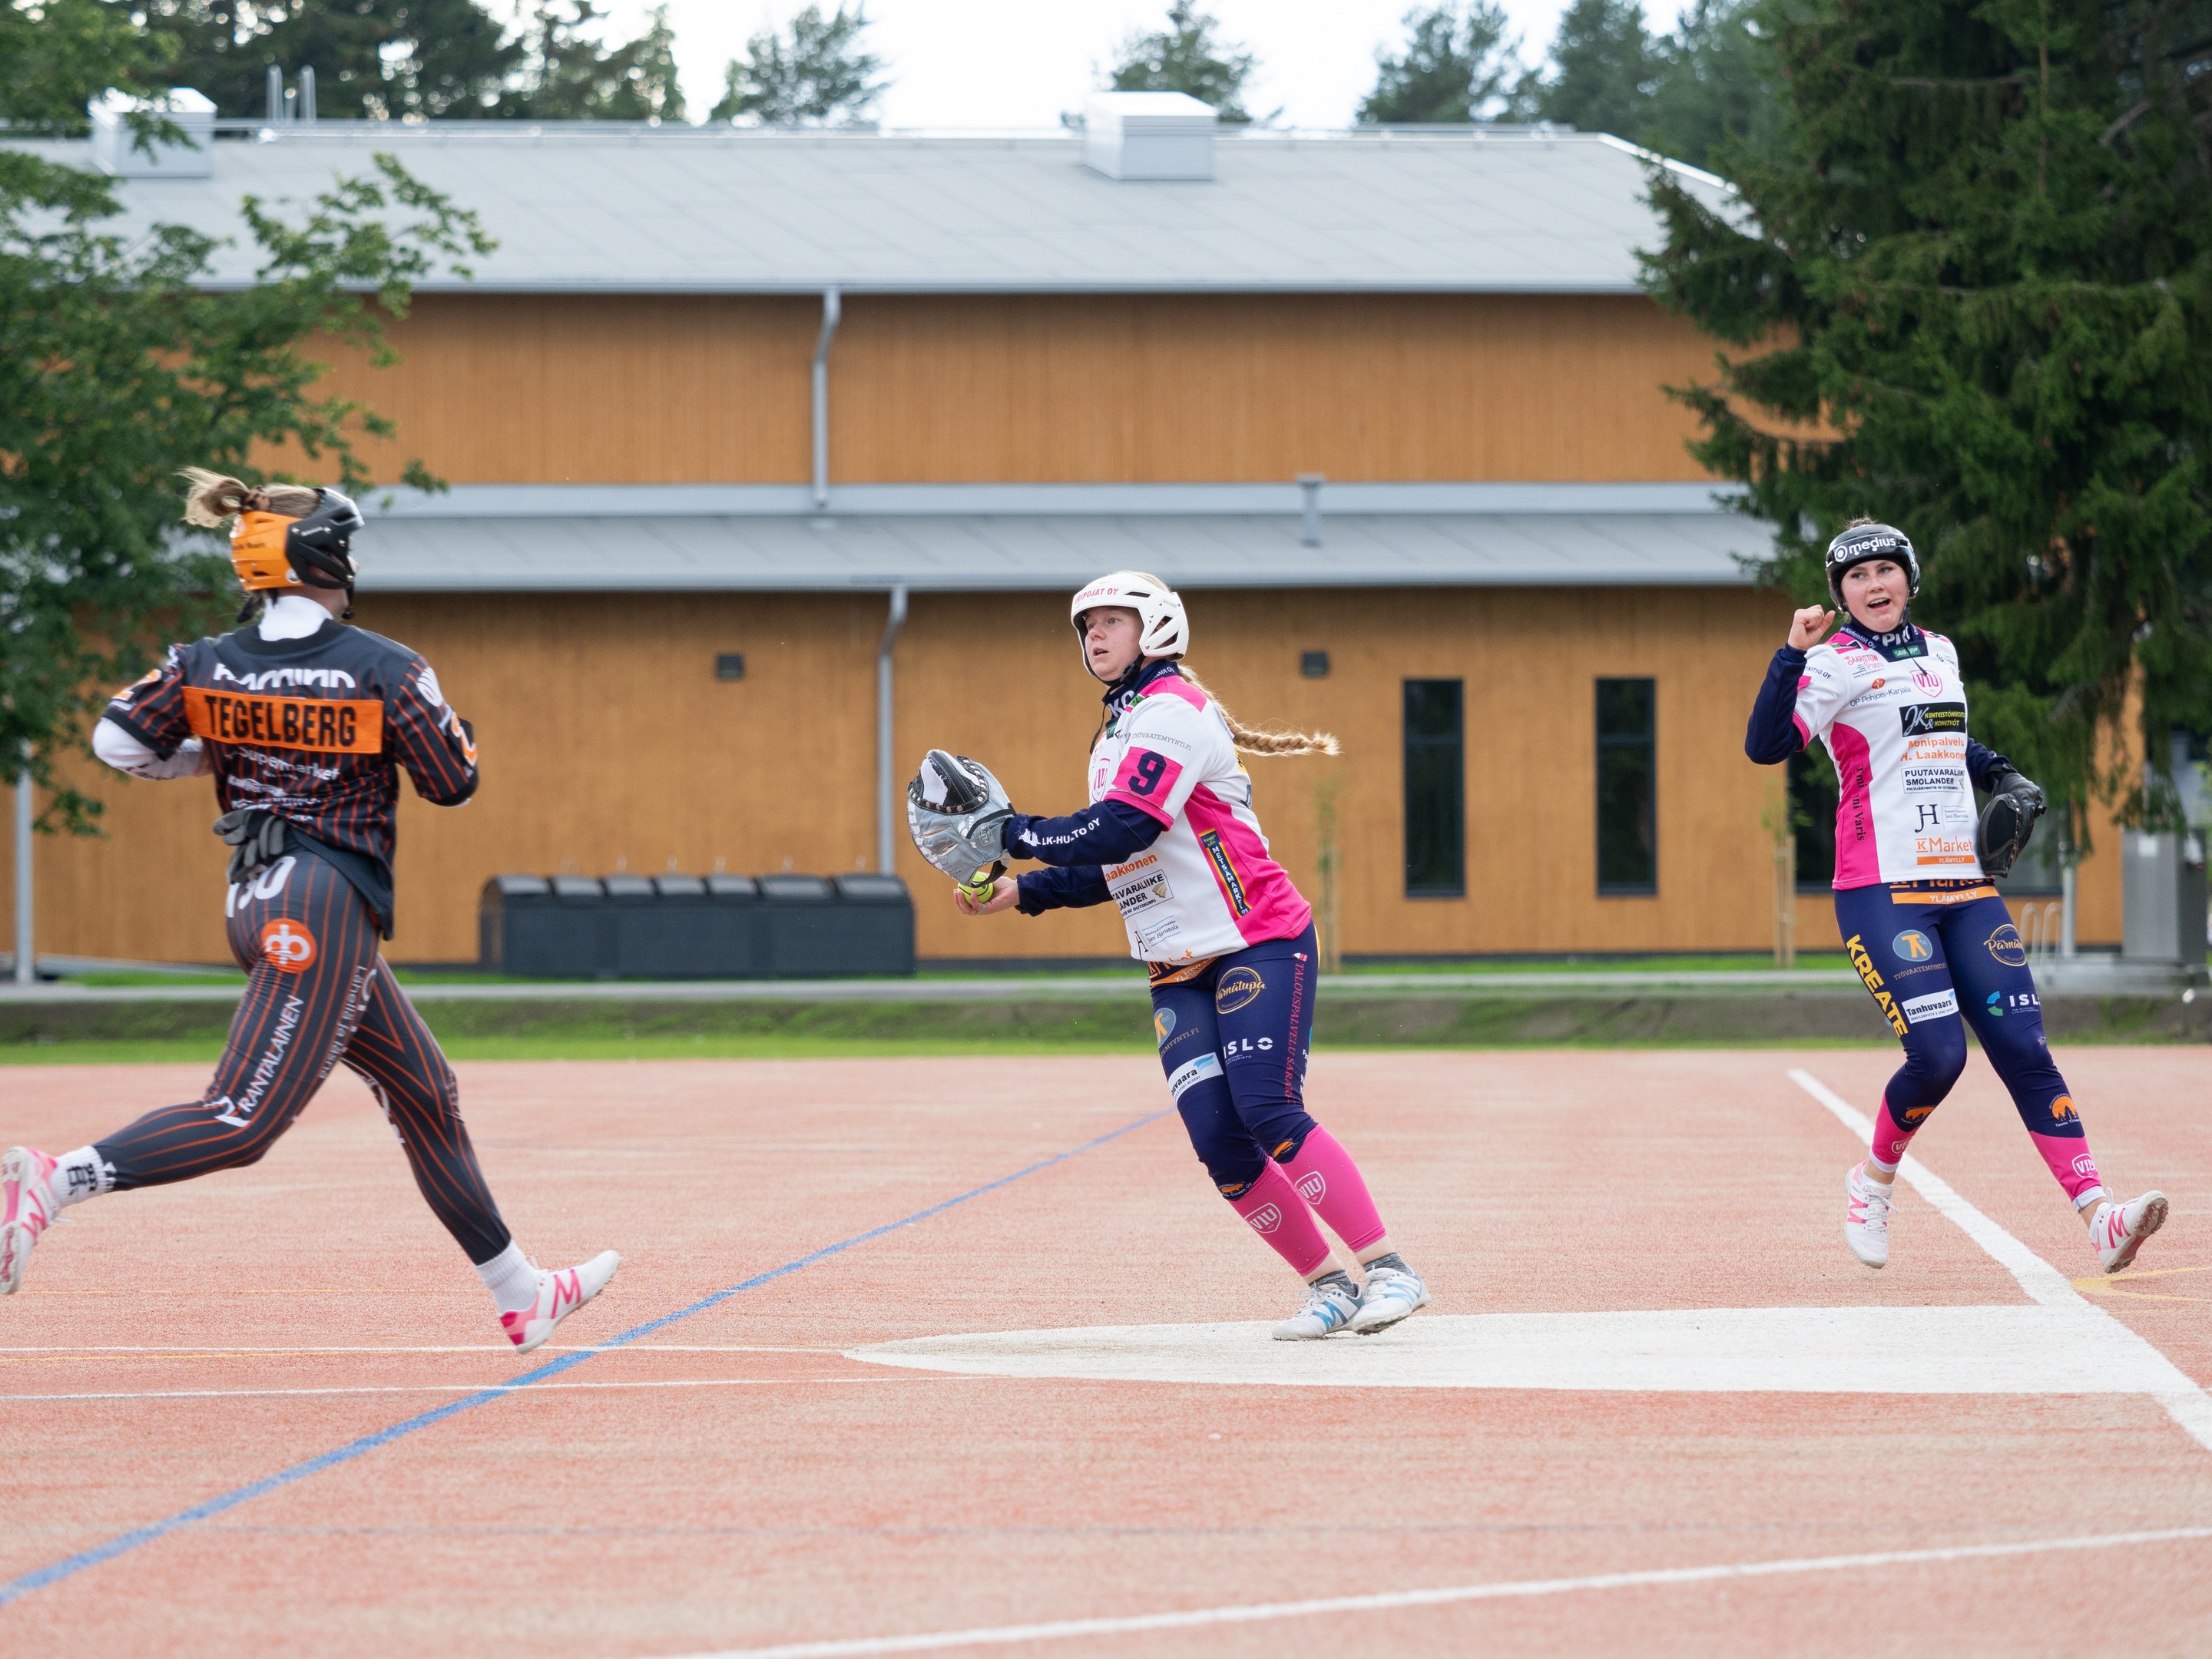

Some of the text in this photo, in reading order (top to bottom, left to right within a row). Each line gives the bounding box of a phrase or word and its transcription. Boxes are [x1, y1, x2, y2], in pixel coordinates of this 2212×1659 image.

[1848, 537, 1896, 556] medius
[1107, 587, 1119, 595] OY
[1850, 687, 1912, 707] OP Pohjois-Karjala
[204, 694, 356, 747] TEGELBERG
[1128, 750, 1167, 796] 9
[1929, 836, 1973, 853] Market
[1929, 890, 1978, 902] YLÄMYLLY
[1846, 934, 1909, 1038] KREATE
[1287, 962, 1304, 1056] TALOUSPALVELU
[1906, 999, 1952, 1016] Tanhuvaara
[237, 995, 304, 1113] RANTALAINEN
[1299, 1177, 1322, 1199] VIU
[1249, 1208, 1278, 1230] VIU
